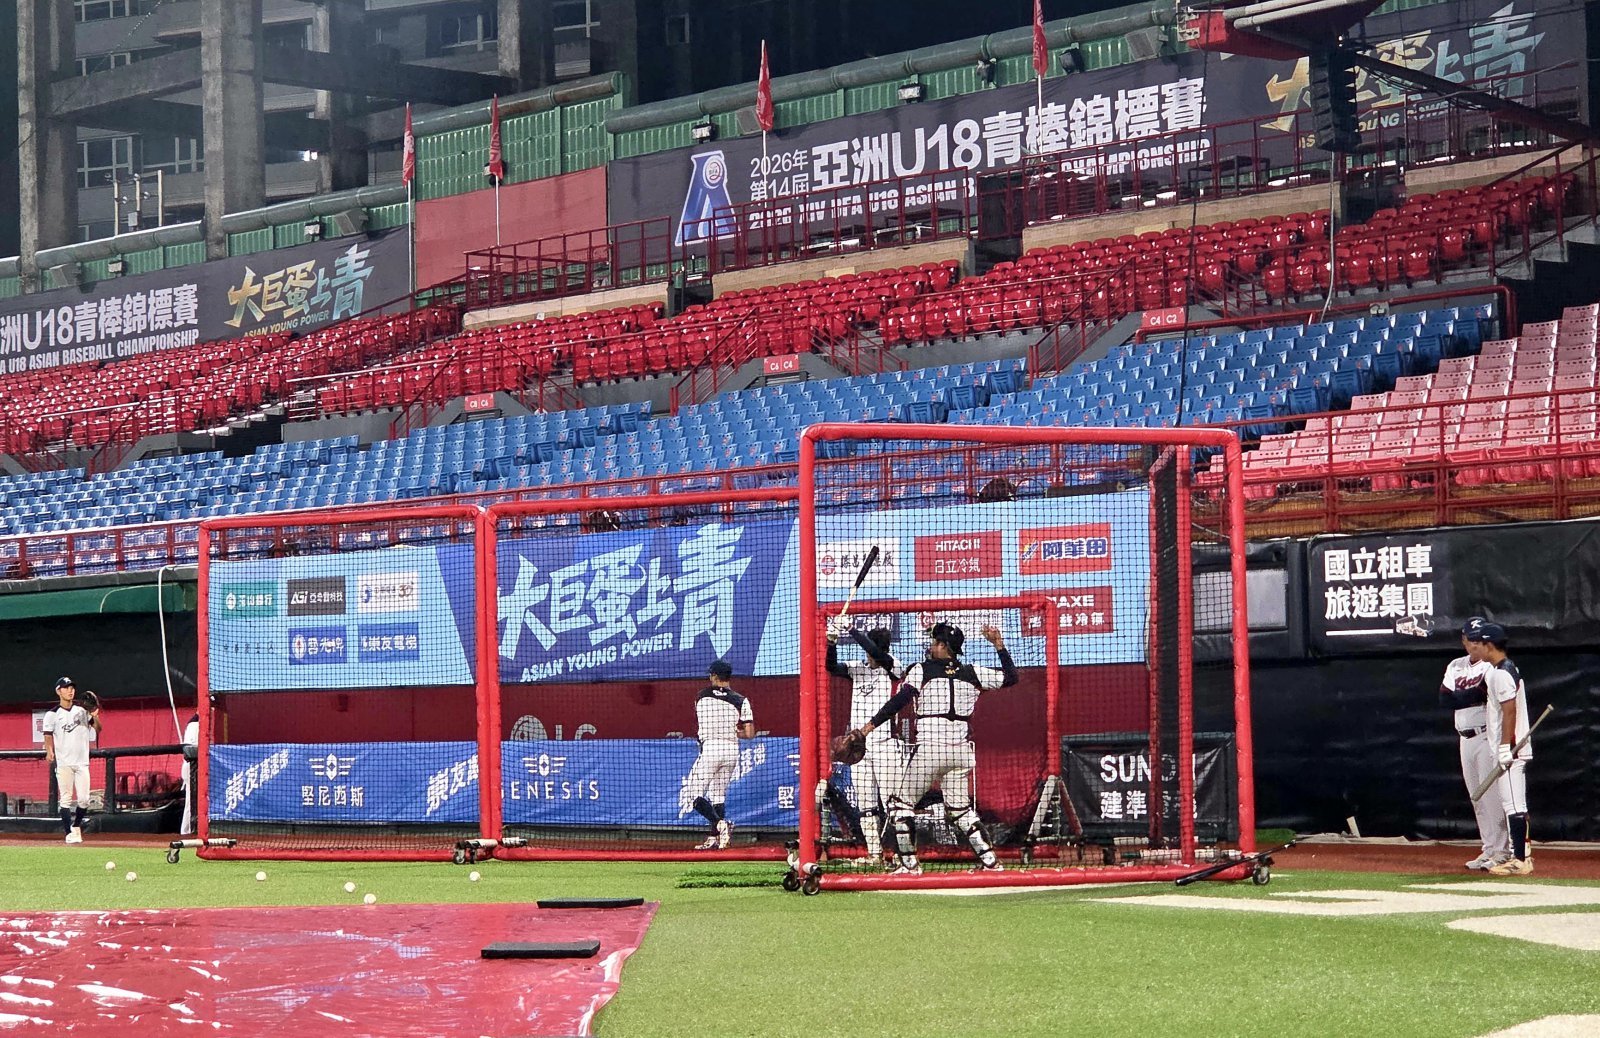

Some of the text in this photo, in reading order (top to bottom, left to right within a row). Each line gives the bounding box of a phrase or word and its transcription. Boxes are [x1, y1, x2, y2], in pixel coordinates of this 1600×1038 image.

[812, 77, 1207, 191] 亞洲U18青棒錦標賽
[750, 149, 808, 178] 2026年
[749, 207, 792, 230] 2026
[831, 194, 863, 219] BFA
[869, 189, 899, 213] U18
[905, 180, 957, 207] ASIAN
[750, 172, 809, 206] 第14屆
[270, 318, 298, 332] YOUNG
[300, 310, 330, 327] POWER
[1166, 314, 1177, 323] C2
[8, 356, 27, 374] U18
[29, 349, 59, 369] ASIAN
[62, 342, 115, 365] BASEBALL
[118, 328, 200, 357] CHAMPIONSHIP
[935, 538, 981, 551] HITACHI
[1041, 537, 1107, 561] 阿華田
[935, 557, 981, 574] 日立冷氣
[1324, 543, 1433, 582] 國立租車
[1324, 582, 1434, 620] 旅遊集團
[520, 632, 673, 683] ASIAN YOUNG POWER
